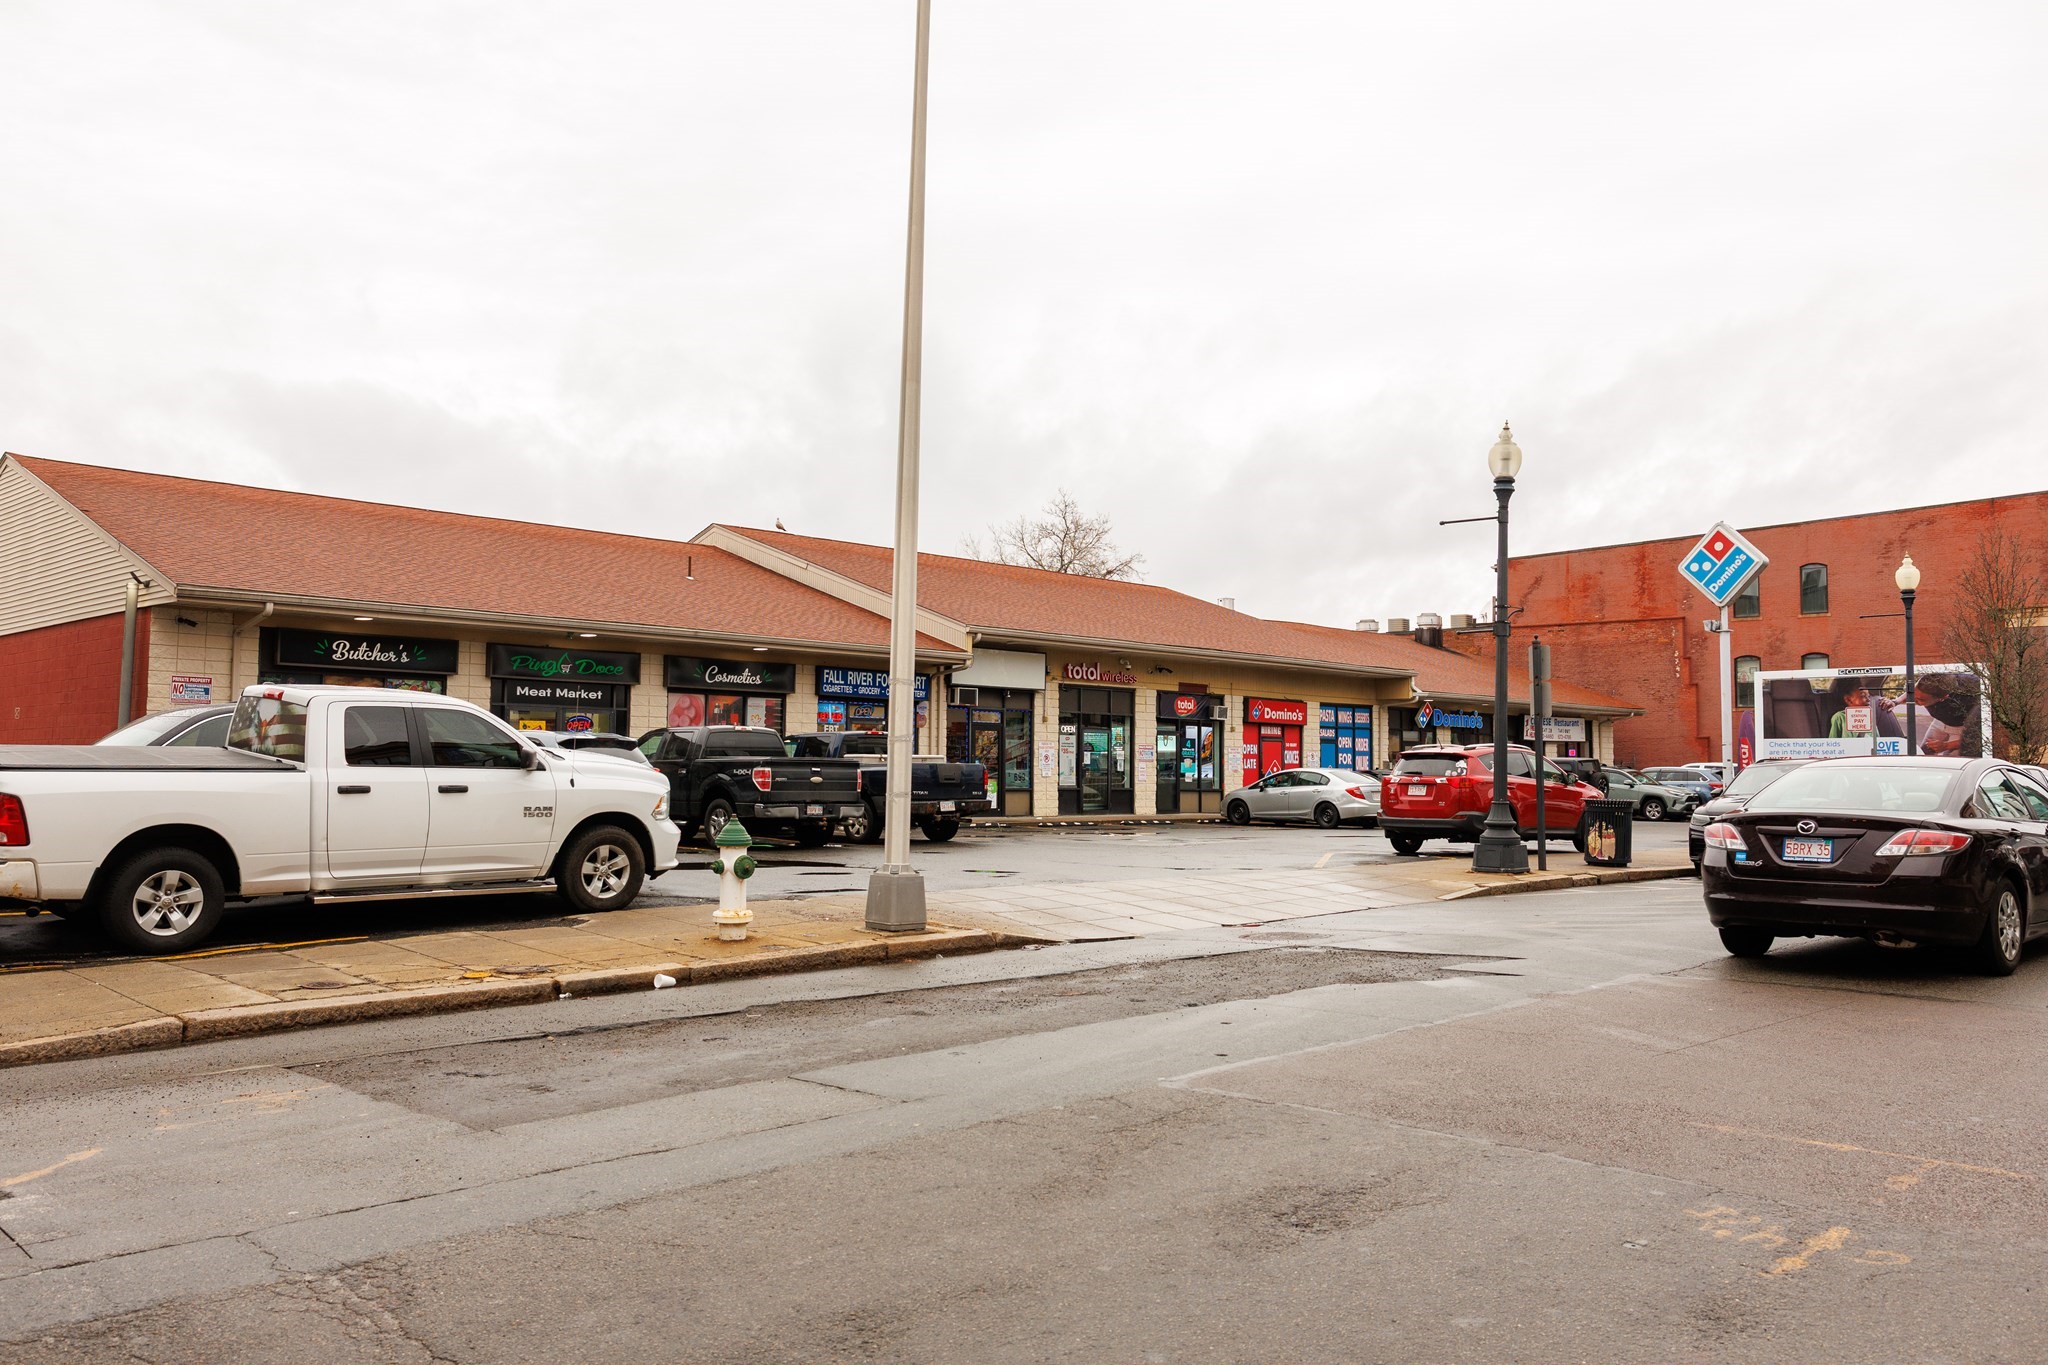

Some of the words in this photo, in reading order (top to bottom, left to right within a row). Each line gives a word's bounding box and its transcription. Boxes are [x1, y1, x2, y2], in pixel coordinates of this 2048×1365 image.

[1708, 553, 1747, 593] Domino's
[332, 639, 410, 663] Butcher's
[575, 659, 624, 675] Doce
[1067, 662, 1100, 681] total
[1101, 672, 1138, 684] wireless
[705, 665, 763, 684] Cosmetics
[823, 669, 845, 684] FALL
[847, 671, 873, 686] RIVER
[876, 674, 890, 687] FO
[173, 683, 184, 695] NO
[516, 686, 552, 697] Meat
[556, 688, 603, 700] Market
[823, 685, 853, 694] CIGARETTES
[858, 687, 881, 695] GROCERY
[1177, 699, 1195, 710] total
[856, 706, 872, 717] OPEN
[1264, 707, 1303, 721] Domino's
[1320, 709, 1335, 723] PASTA
[1433, 708, 1483, 729] Domino's
[1554, 719, 1580, 727] Restaurant
[567, 721, 591, 730] OPEN
[1320, 729, 1335, 738] SALADS
[1338, 736, 1352, 749] OPEN
[1877, 741, 1900, 752] OVE
[1243, 744, 1258, 755] OPEN
[1244, 759, 1257, 769] LATE
[1338, 754, 1352, 765] FOR
[1786, 843, 1813, 856] 5BRX
[1816, 844, 1830, 857] 35
